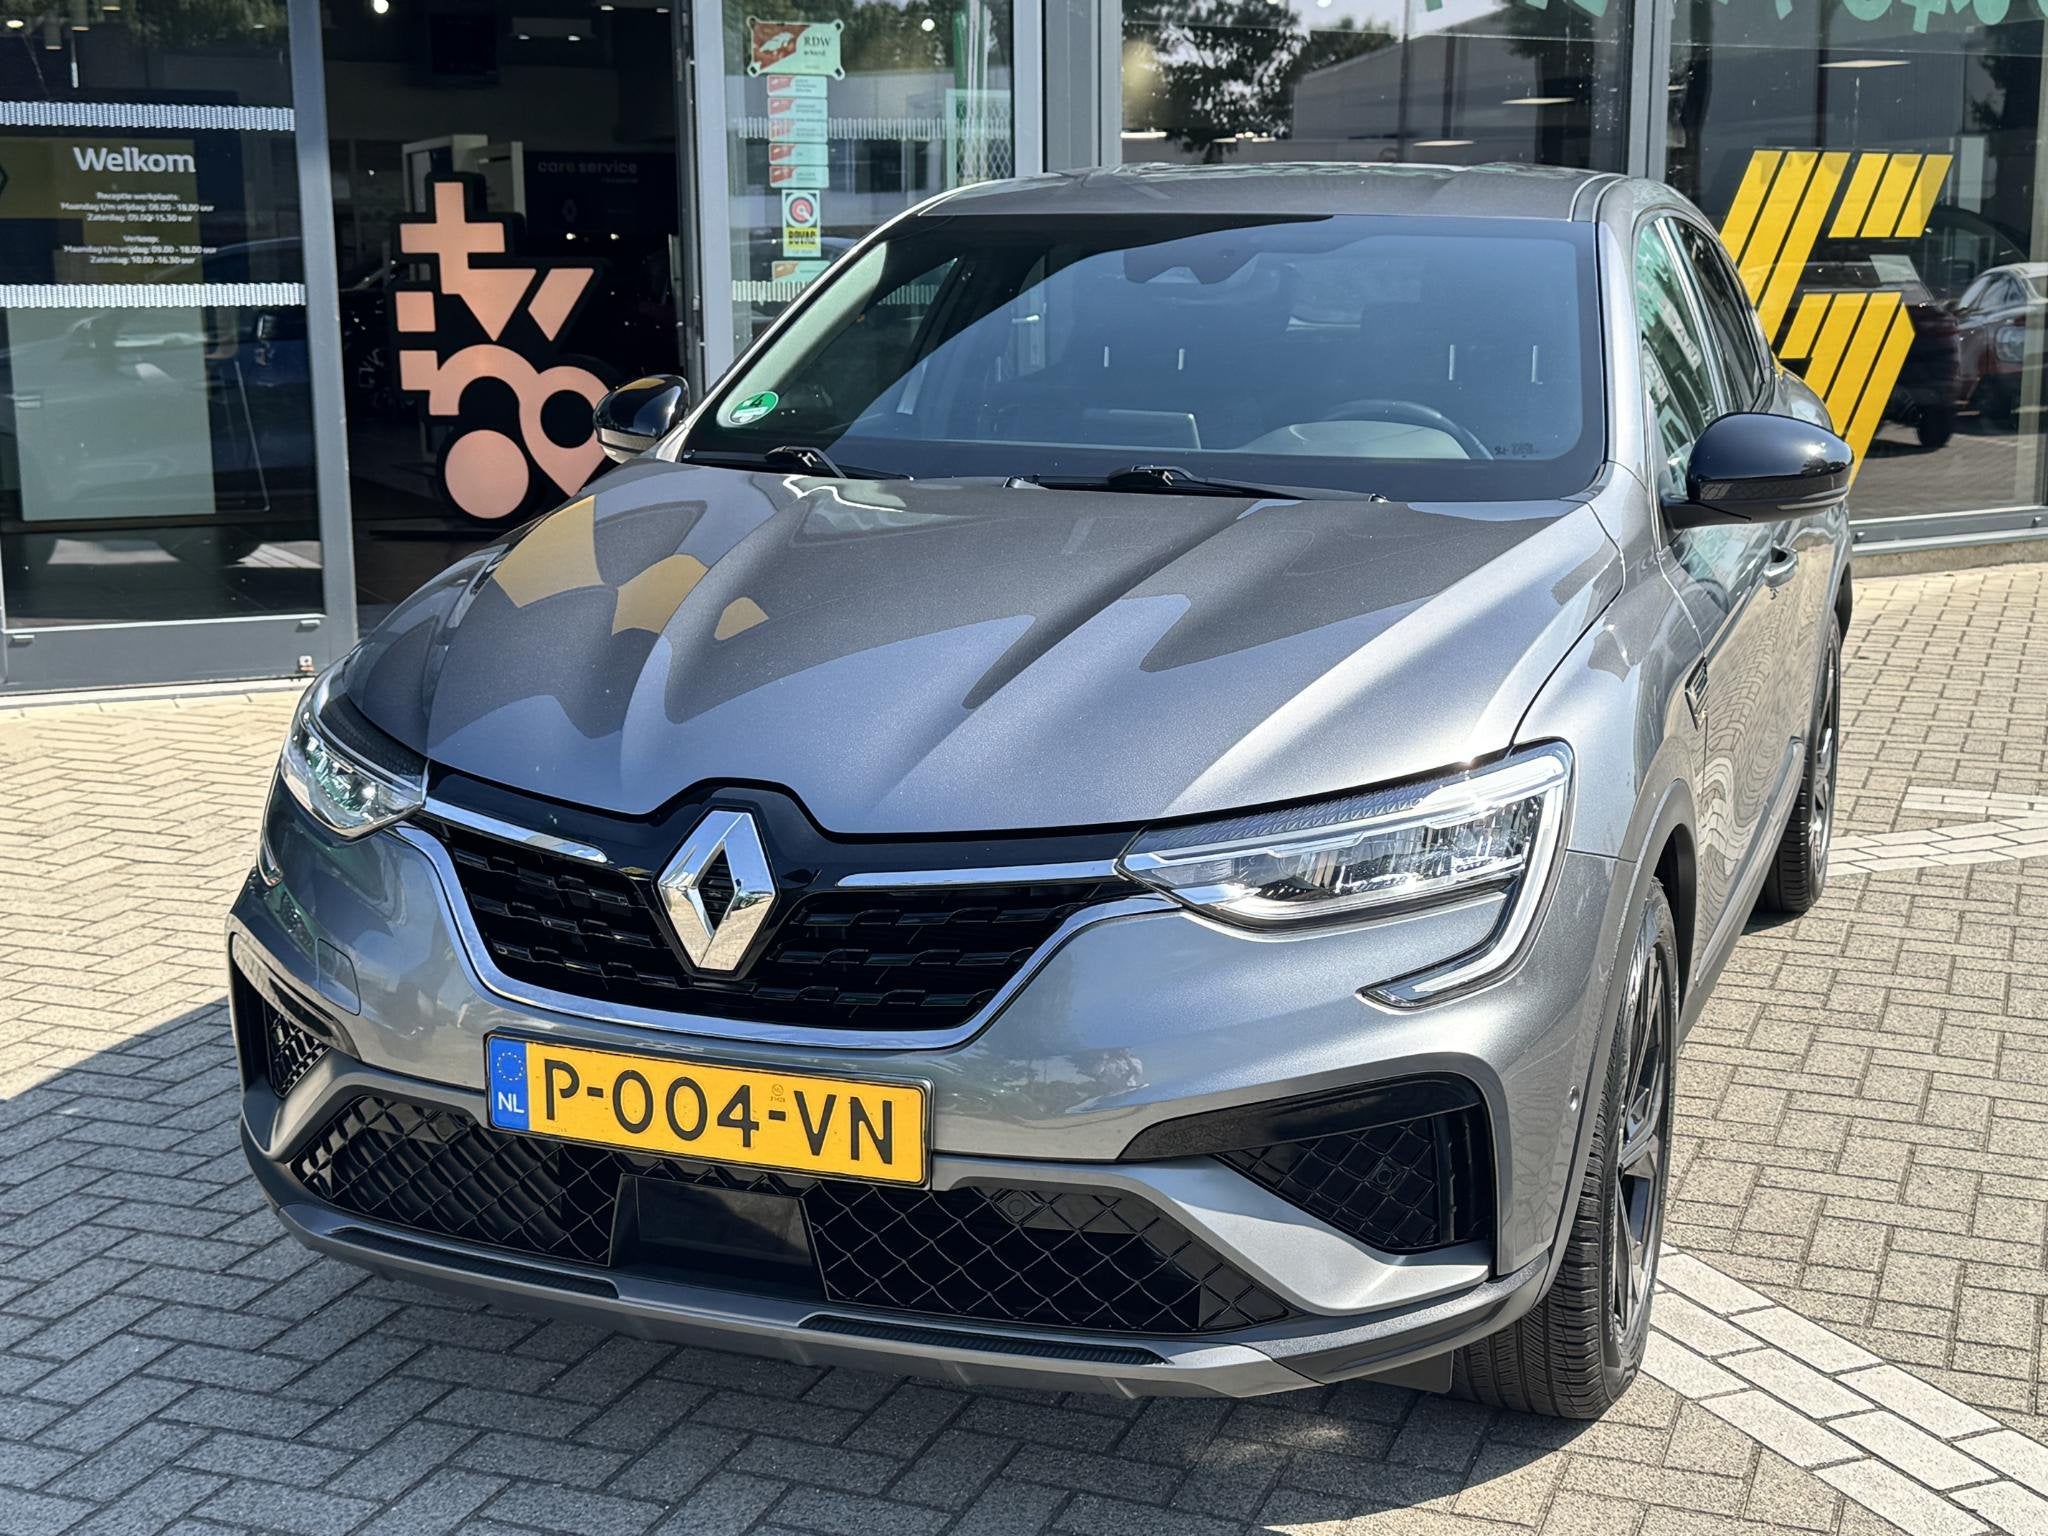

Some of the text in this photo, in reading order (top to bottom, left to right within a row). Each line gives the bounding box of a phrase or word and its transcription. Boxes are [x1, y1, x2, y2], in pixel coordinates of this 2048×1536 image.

[804, 36, 831, 47] RDW
[72, 145, 196, 173] Welkom
[578, 160, 638, 173] service
[96, 191, 132, 202] Receptie
[60, 202, 100, 212] Maandag
[63, 245, 102, 254] Maandag
[203, 246, 217, 254] uur
[181, 257, 195, 265] uur
[497, 1091, 525, 1114] NL
[543, 1057, 894, 1165] P-004-VN
